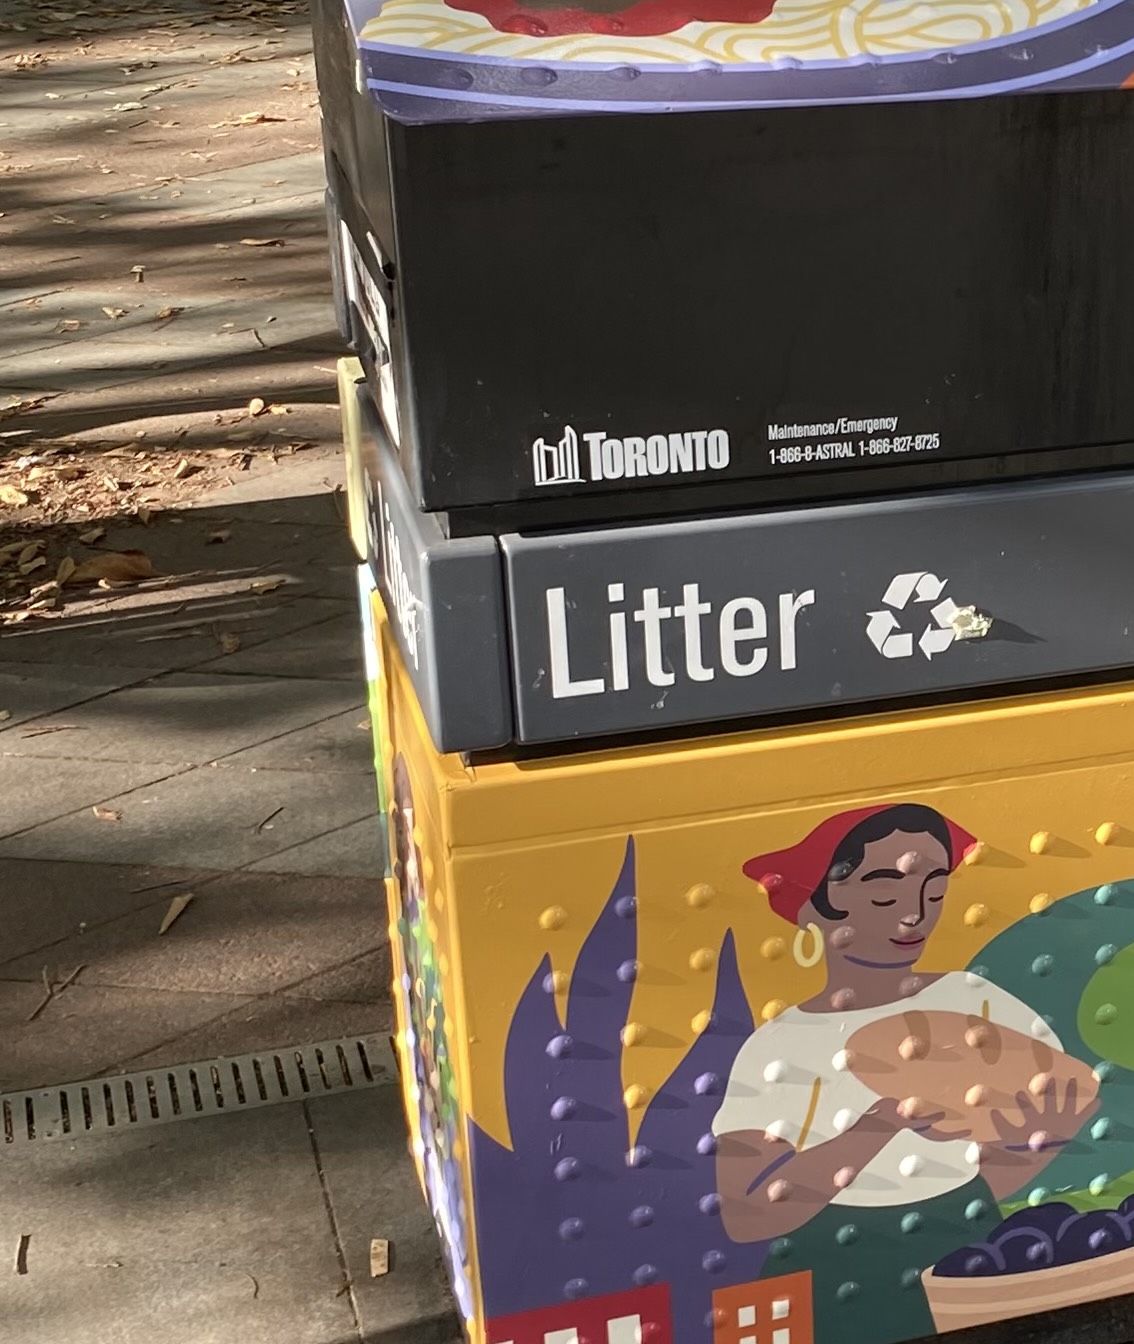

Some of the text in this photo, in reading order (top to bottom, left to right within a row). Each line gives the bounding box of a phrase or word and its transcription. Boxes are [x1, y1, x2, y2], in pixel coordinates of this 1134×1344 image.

[767, 416, 898, 441] Maintenance/Emergency
[768, 433, 940, 465] 1-866-8-ASTRAL 1-866-827-8725
[546, 583, 815, 698] Litter
